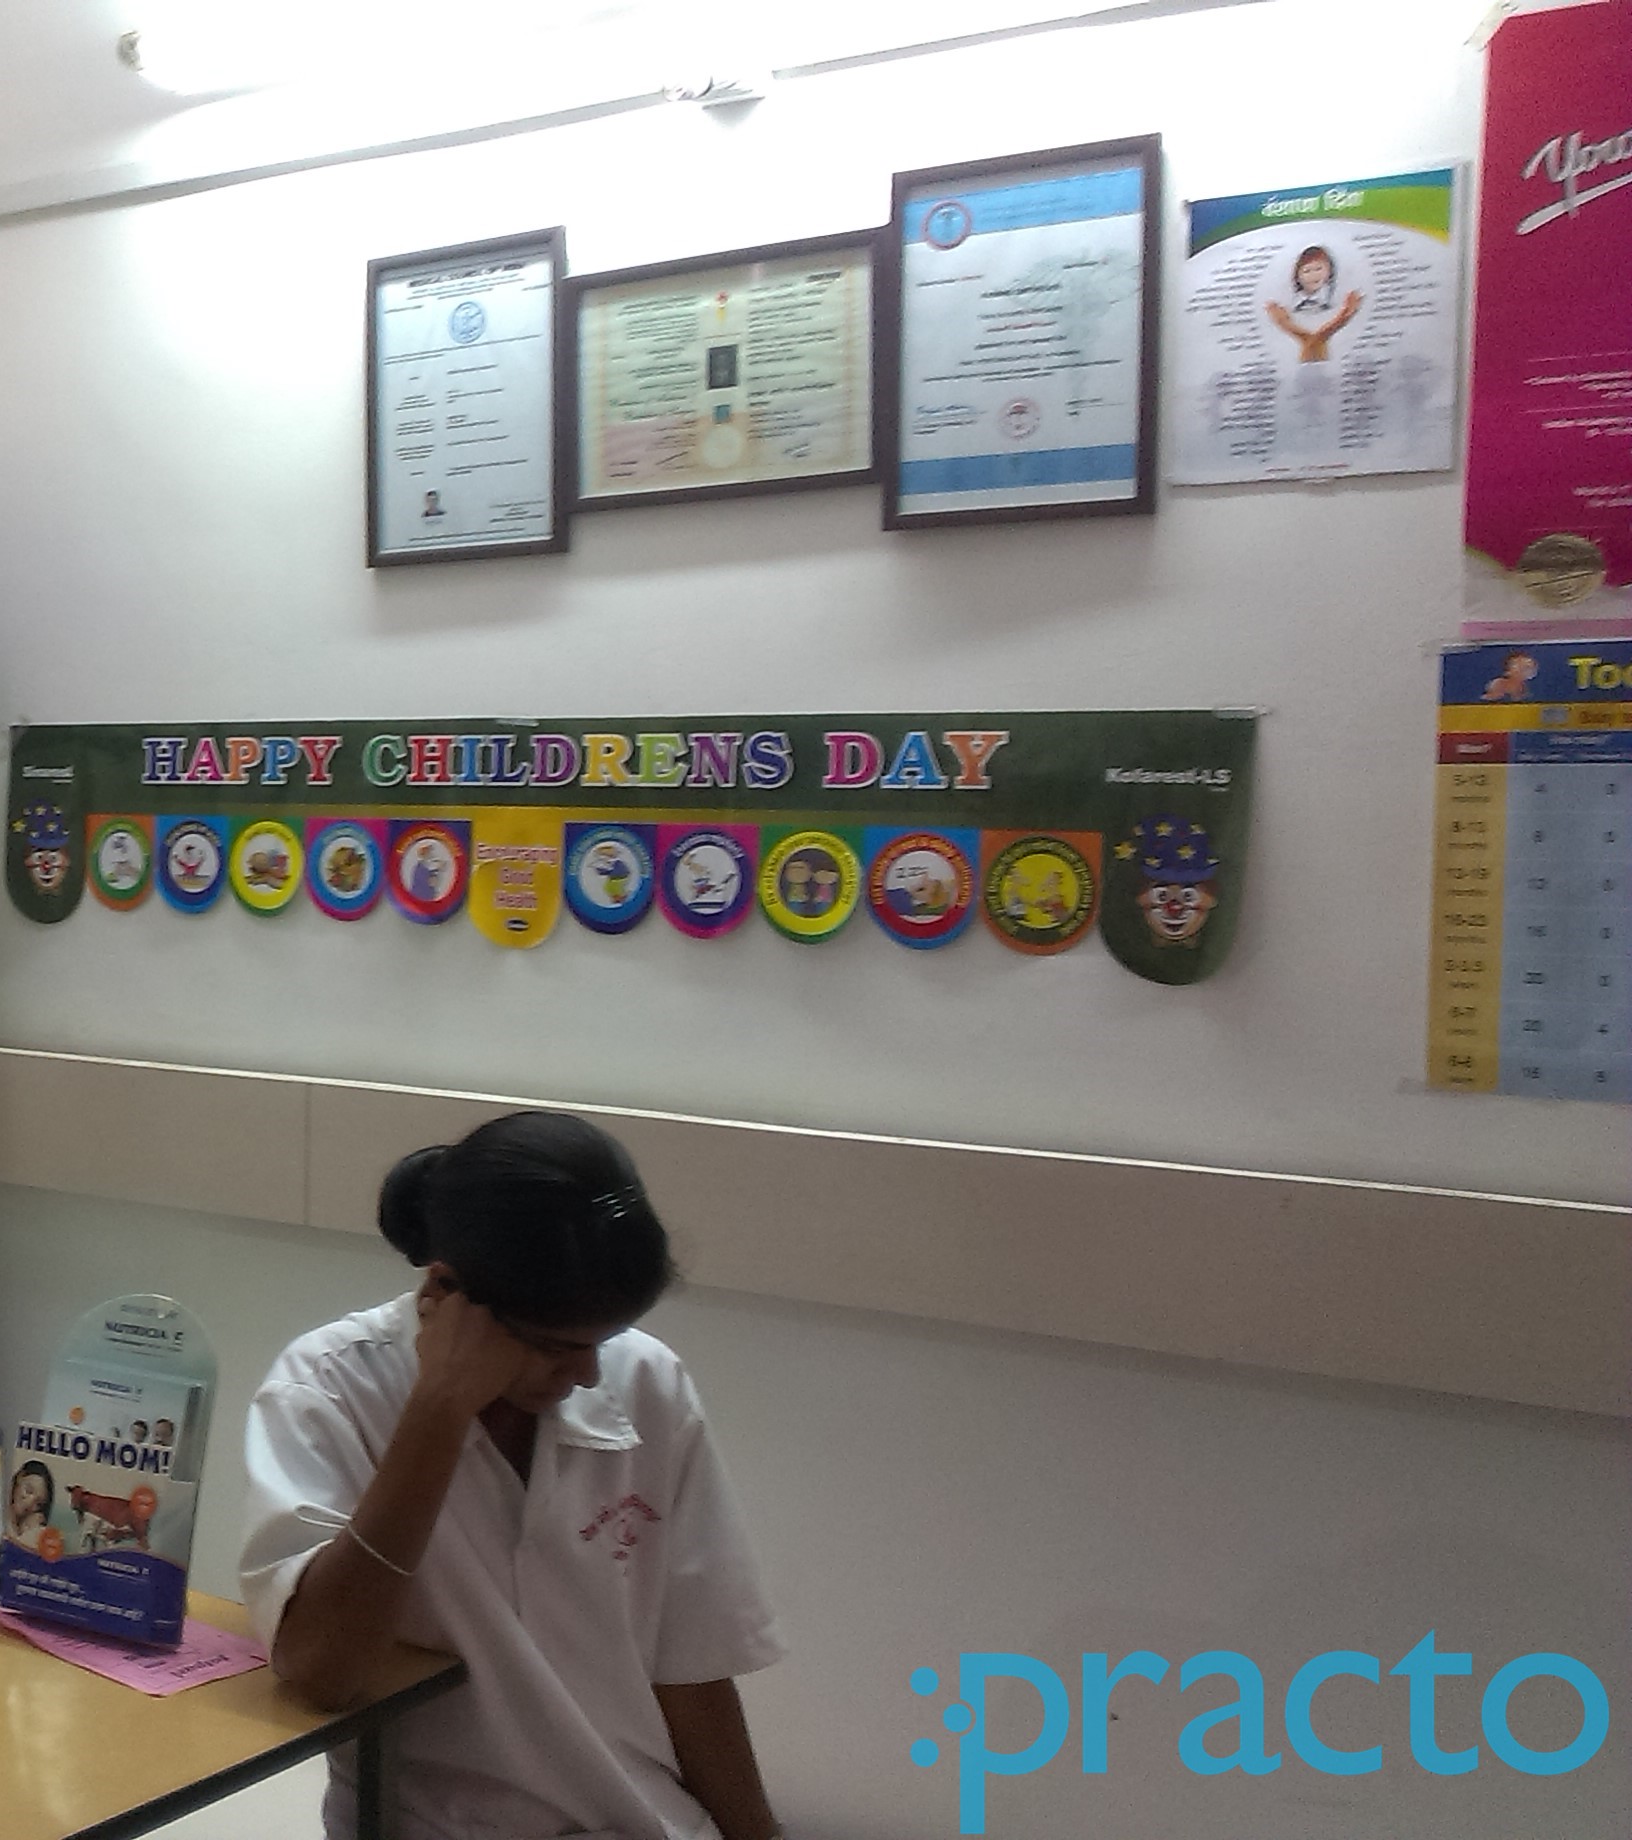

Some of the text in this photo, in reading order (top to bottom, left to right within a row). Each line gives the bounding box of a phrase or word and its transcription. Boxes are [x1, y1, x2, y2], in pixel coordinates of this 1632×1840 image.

[141, 731, 1010, 790] HAPPY CHILDRENS DAY
[16, 1423, 170, 1475] HELLO MOM!
